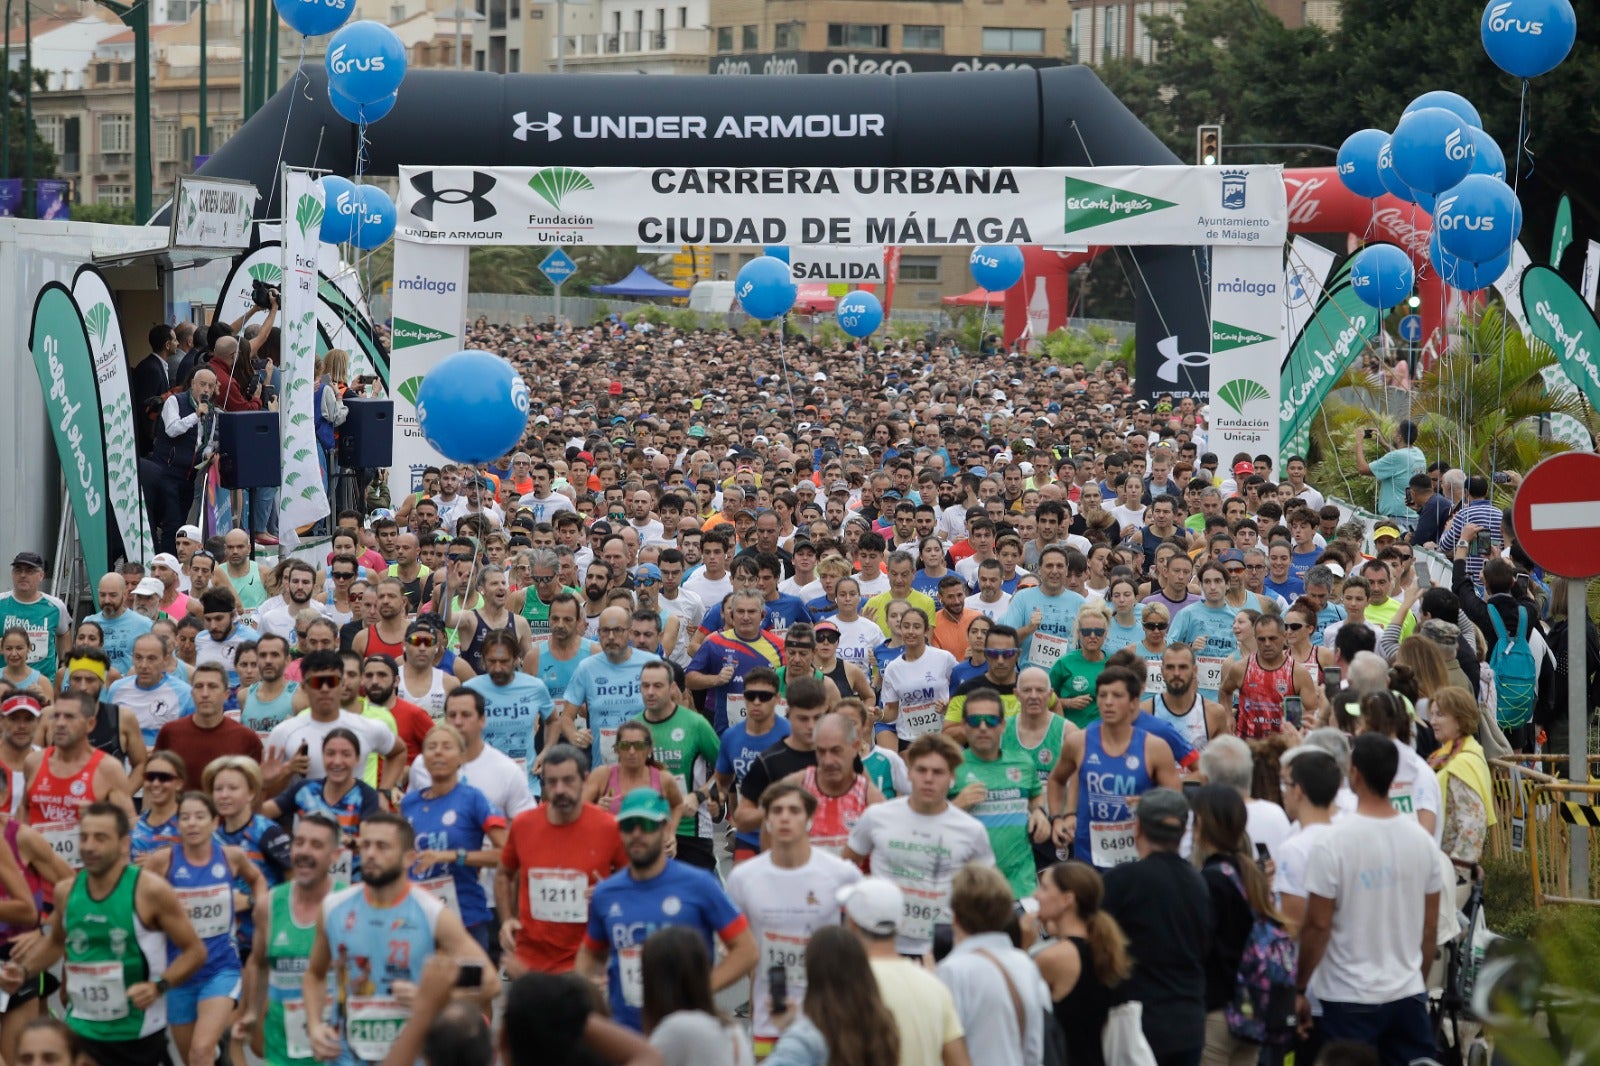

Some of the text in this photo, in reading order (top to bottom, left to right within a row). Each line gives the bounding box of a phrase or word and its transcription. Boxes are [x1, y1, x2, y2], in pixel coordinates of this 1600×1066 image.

[1488, 1, 1544, 35] Forus
[330, 43, 385, 74] Forus
[573, 113, 885, 139] UNDER ARMOUR
[652, 168, 1020, 194] CARRERA URBANA
[1080, 196, 1109, 210] Corte
[1109, 194, 1153, 214] Inglés
[529, 214, 593, 225] Fundación
[1436, 195, 1495, 231] Forus
[638, 211, 1033, 245] CIUDAD DE MÁLAGA
[1197, 216, 1270, 229] Ayuntamiento
[405, 228, 503, 240] UNDER ARMOUR
[538, 230, 583, 244] Unicaja
[1206, 229, 1260, 240] de Málaga
[792, 262, 881, 279] SALIDA
[1217, 418, 1269, 428] Fundación
[1223, 431, 1261, 443] Unicaja
[1037, 644, 1061, 658] 1556
[907, 712, 939, 728] 13922
[653, 747, 682, 762] ijas
[1087, 771, 1136, 796] RCM
[1101, 836, 1135, 851] 6490
[540, 888, 577, 903] 1211
[82, 986, 109, 1002] 133
